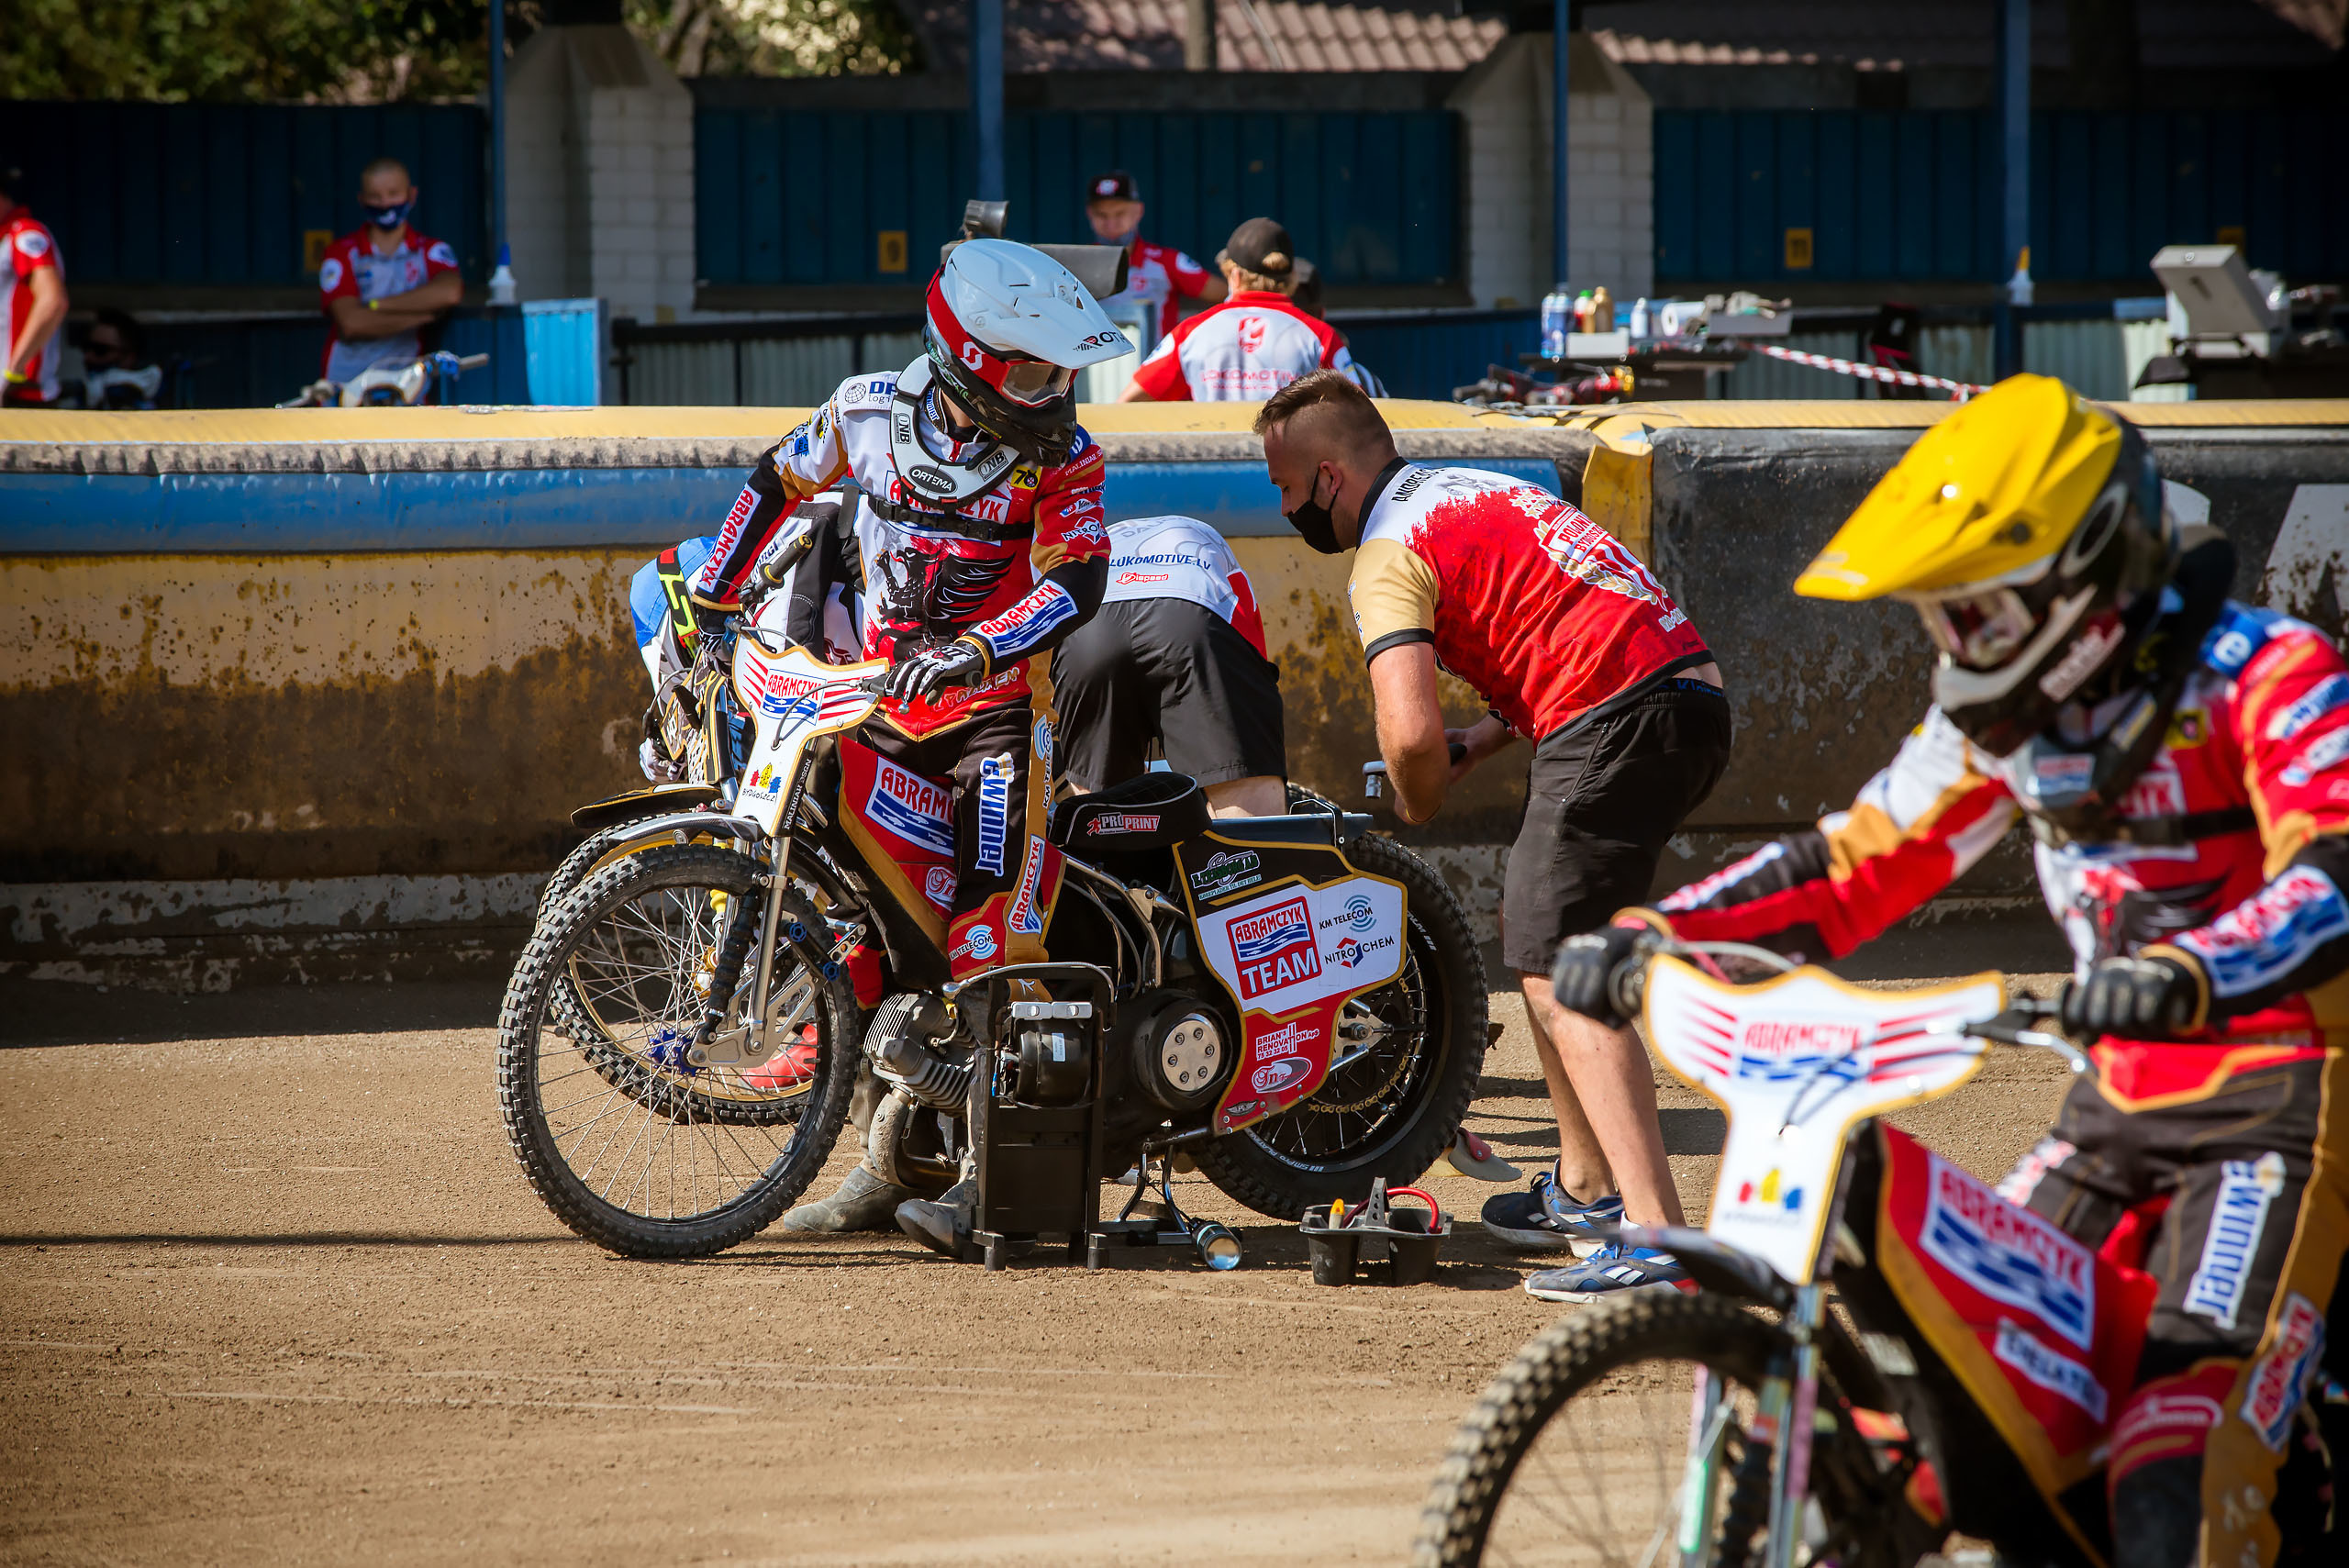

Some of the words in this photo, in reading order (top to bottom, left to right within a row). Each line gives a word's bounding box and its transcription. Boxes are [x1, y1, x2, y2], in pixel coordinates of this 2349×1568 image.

[868, 395, 891, 404] logi
[911, 469, 952, 491] ORTEMA
[702, 489, 754, 587] ABRAMCZYK
[1557, 514, 1594, 545] POLONI
[980, 584, 1063, 637] ABRAMCZYK
[766, 674, 822, 701] ABRAMCZYK
[742, 788, 775, 802] BYDGOSZCZ
[784, 784, 803, 830] MALINIAK
[881, 767, 954, 823] ABRAMC
[1043, 785, 1051, 807] KM
[1011, 840, 1041, 930] ABRAMCZYK
[1235, 906, 1305, 943] ABRAMCZYK
[1319, 918, 1333, 930] KM
[1333, 906, 1374, 926] TELECOM
[957, 935, 993, 954] TELECOM
[1324, 947, 1356, 965] NITRO
[1362, 935, 1395, 953] CHEM
[1241, 947, 1319, 995] TEAM
